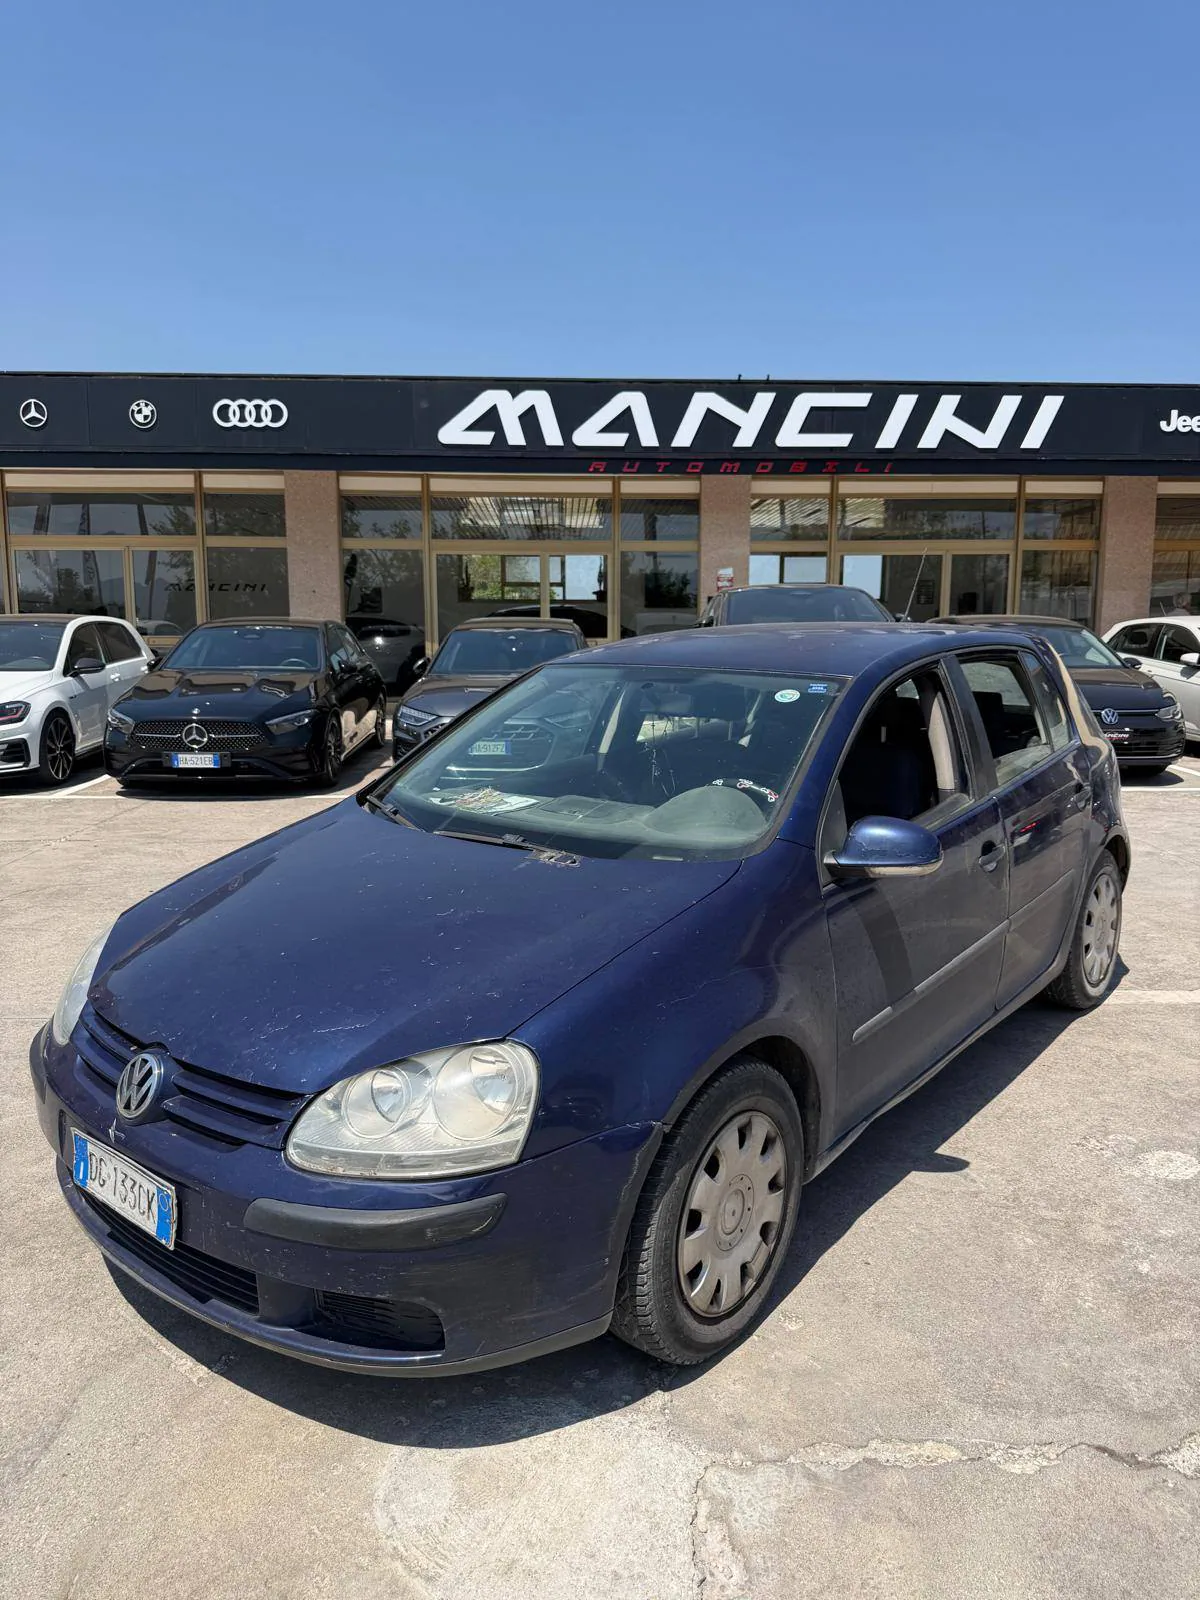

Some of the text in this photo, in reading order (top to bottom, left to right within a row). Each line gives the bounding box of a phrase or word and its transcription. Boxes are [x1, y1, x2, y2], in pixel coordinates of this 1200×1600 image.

[437, 389, 1065, 449] MANCINI
[1160, 409, 1200, 432] Jee
[588, 461, 893, 473] AUTOMOBILI
